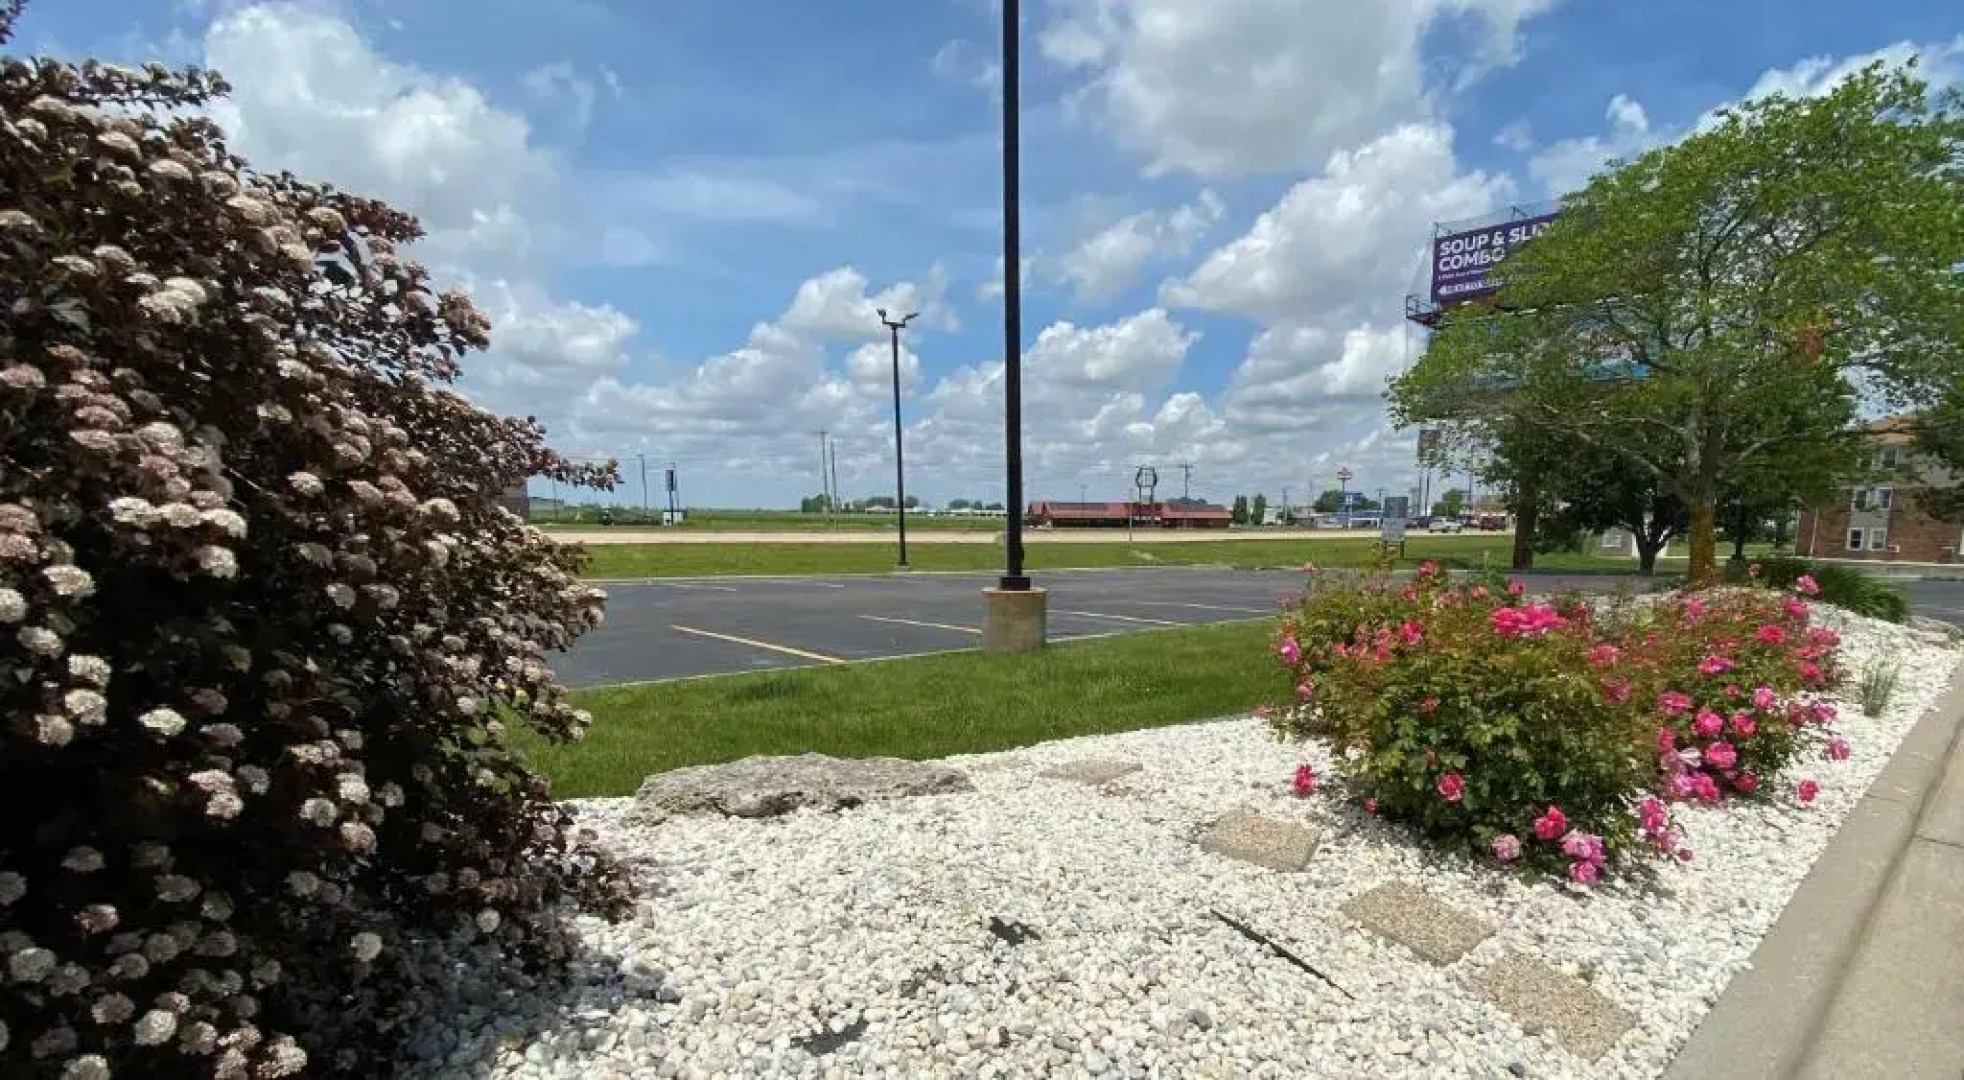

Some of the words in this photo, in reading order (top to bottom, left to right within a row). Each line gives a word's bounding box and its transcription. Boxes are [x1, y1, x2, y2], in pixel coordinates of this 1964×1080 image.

[1440, 233, 1489, 256] SOUP
[1492, 231, 1505, 246] &
[1439, 247, 1505, 272] COMBO
